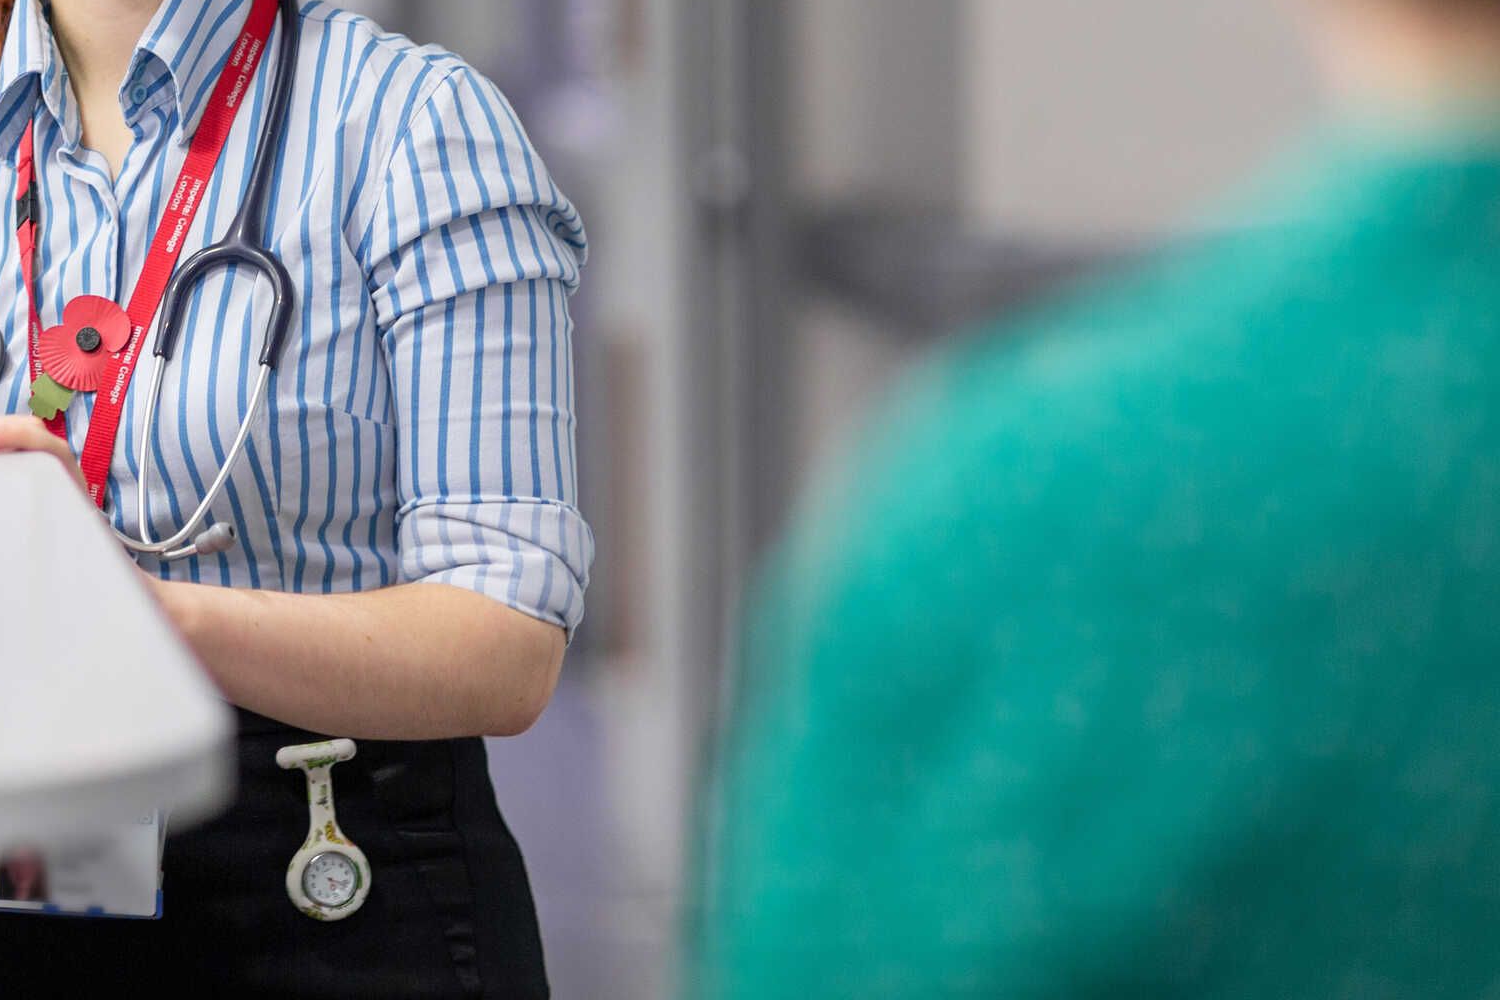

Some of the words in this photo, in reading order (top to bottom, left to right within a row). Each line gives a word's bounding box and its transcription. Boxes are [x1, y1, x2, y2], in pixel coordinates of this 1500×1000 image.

[232, 32, 253, 67] London
[242, 38, 261, 74] Imperial
[226, 74, 247, 108] College
[171, 175, 192, 211] London
[182, 179, 204, 216] Imperial
[166, 218, 187, 253] College
[123, 325, 144, 364] Imperial
[110, 366, 129, 405] College
